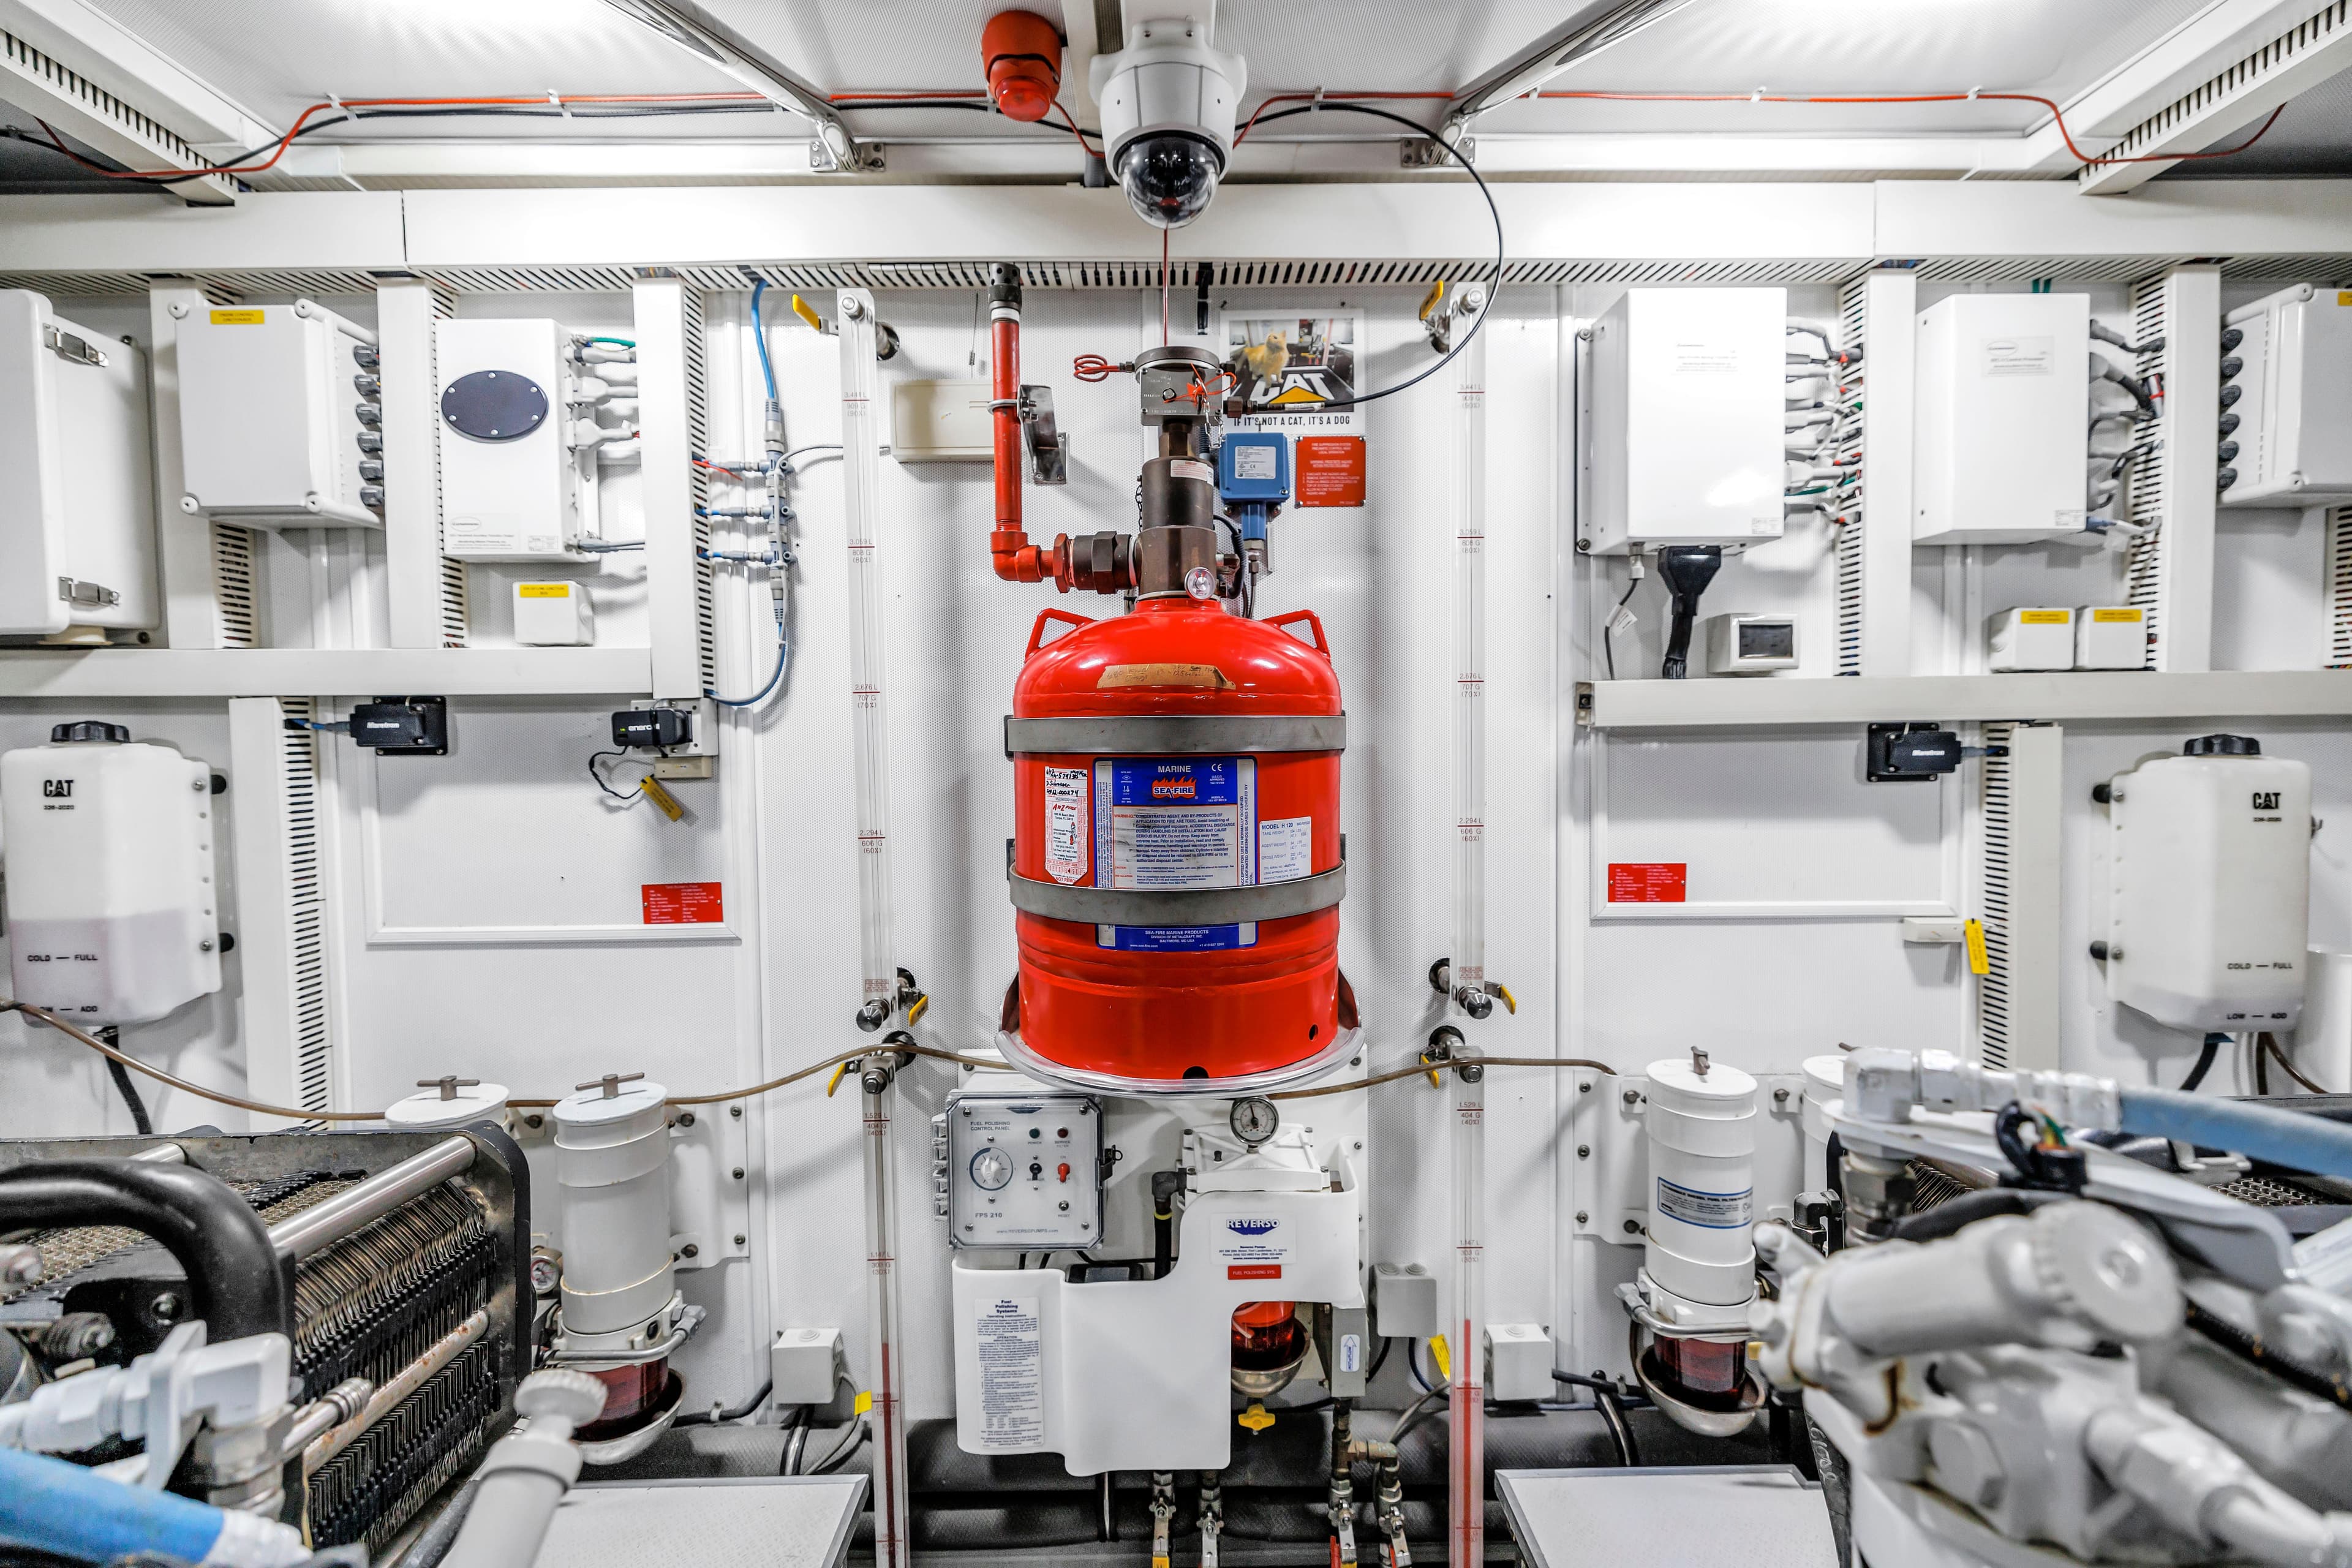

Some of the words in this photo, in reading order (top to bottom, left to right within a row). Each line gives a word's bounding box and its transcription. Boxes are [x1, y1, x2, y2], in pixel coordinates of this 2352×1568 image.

[1250, 373, 1335, 404] CAT
[1244, 417, 1259, 426] IT'S
[1262, 417, 1278, 426] NOT
[1281, 417, 1285, 426] A
[1288, 417, 1305, 426] CAT,
[1309, 416, 1324, 425] IT'S
[1327, 416, 1331, 424] A
[1335, 416, 1350, 424] DOG
[43, 779, 74, 797] CAT
[1154, 786, 1194, 796] SEA-FIRE
[2253, 792, 2281, 809] CAT
[1226, 1219, 1280, 1228] REVERSO
